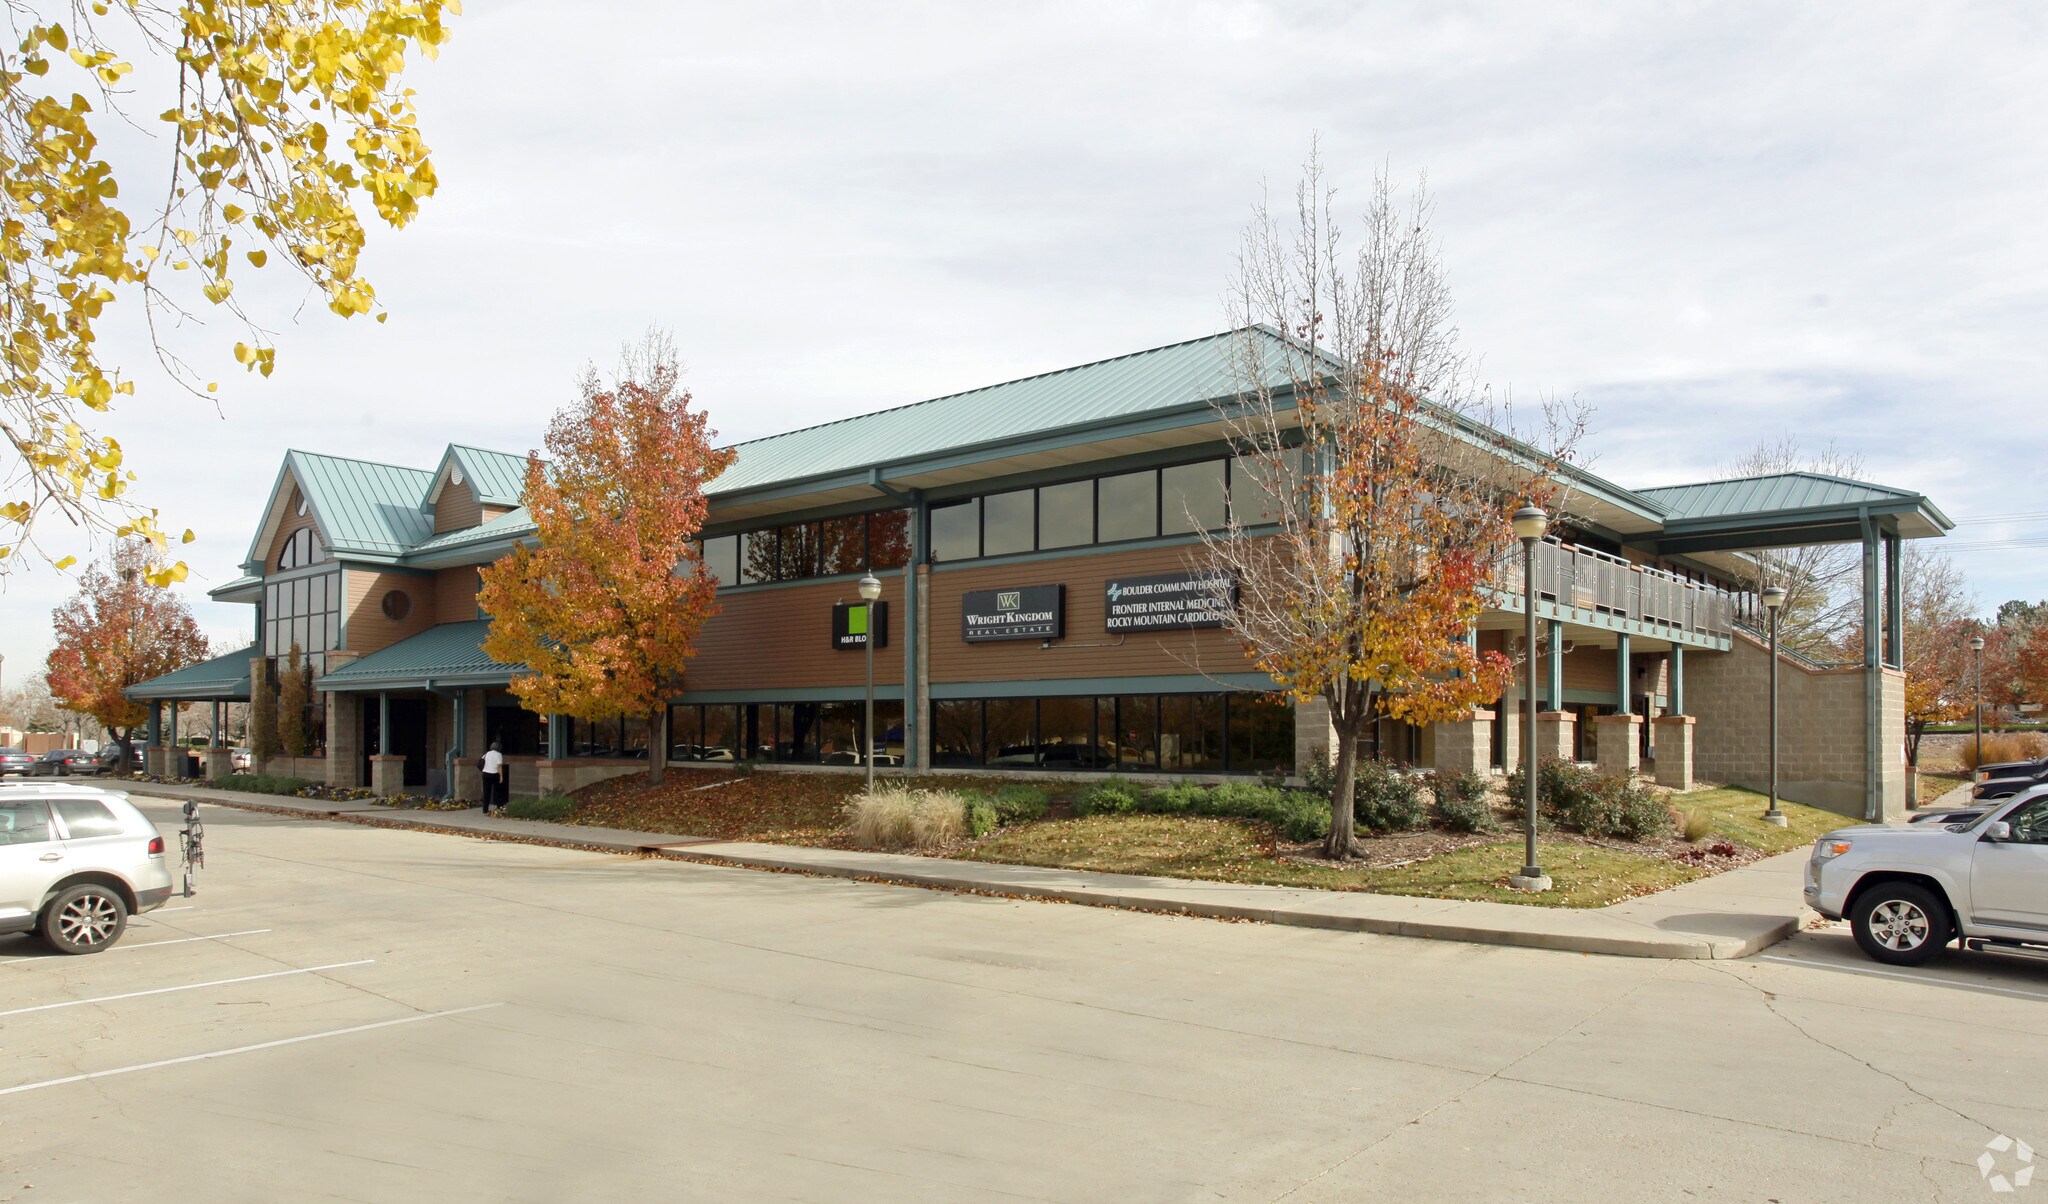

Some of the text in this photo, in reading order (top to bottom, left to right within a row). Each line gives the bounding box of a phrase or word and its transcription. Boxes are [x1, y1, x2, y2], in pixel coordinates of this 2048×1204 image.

[1122, 584, 1153, 596] BOULDER
[1153, 581, 1198, 593] COMMUNITY
[999, 593, 1018, 608] WK
[1112, 603, 1147, 615] FRONTIER
[1148, 600, 1184, 612] INTERNAL
[1107, 616, 1133, 628] ROCKY
[1133, 613, 1177, 626] MOUNTAIN
[1005, 625, 1051, 634] ESTATE
[840, 635, 868, 644] H&R BLO
